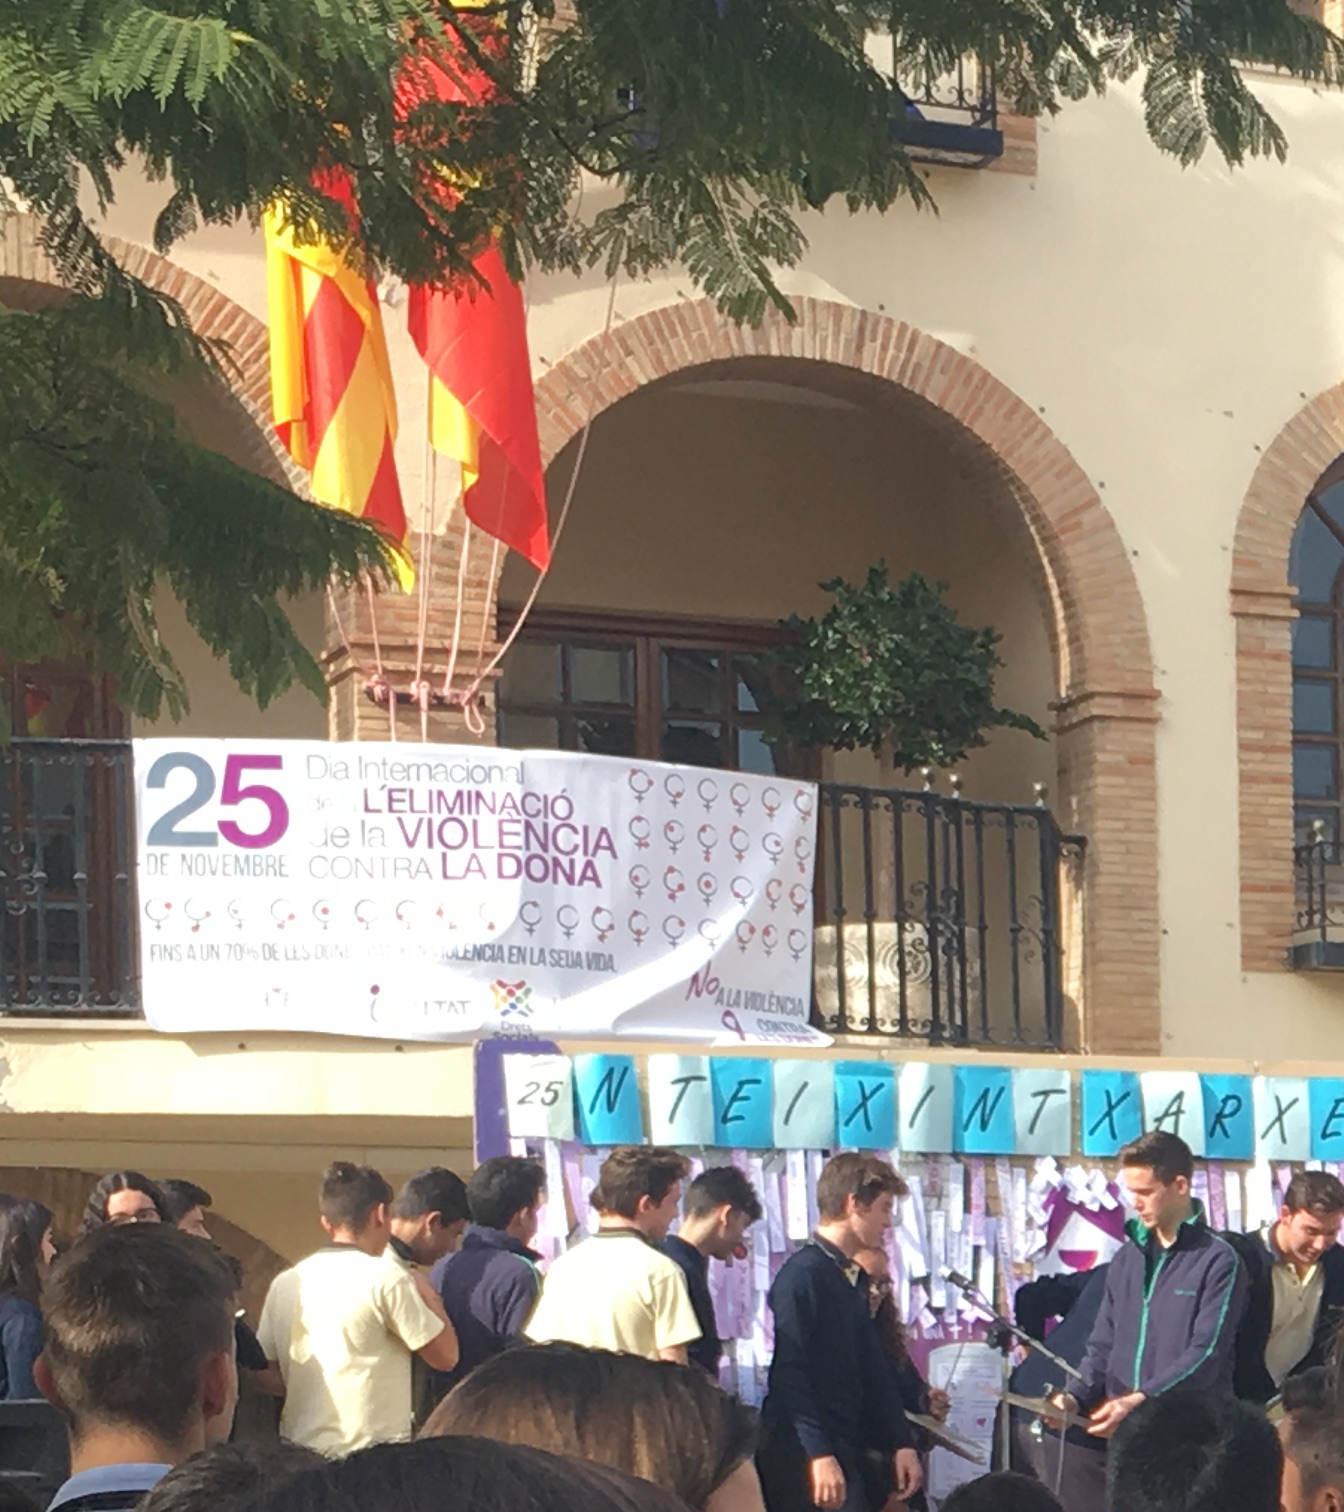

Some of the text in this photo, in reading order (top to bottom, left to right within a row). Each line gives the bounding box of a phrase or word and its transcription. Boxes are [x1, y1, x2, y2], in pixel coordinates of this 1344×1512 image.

[306, 754, 524, 785] Dia Internacional
[147, 752, 290, 849] 25
[361, 818, 388, 849] la
[396, 812, 618, 860] VIOLÈNCIA
[146, 853, 289, 878] DE NOVEMBRE
[308, 851, 602, 888] CONTRA LA DONA
[150, 944, 183, 963] FINS
[187, 945, 197, 961] A
[200, 944, 220, 961] UN
[262, 943, 280, 961] DE
[284, 943, 310, 961] LES
[507, 945, 527, 965] EN
[529, 946, 547, 967] LA
[548, 948, 583, 970] SEUA
[684, 960, 720, 1001] No
[726, 988, 743, 1009] LA
[743, 989, 805, 1018] VIOLÈNCIA
